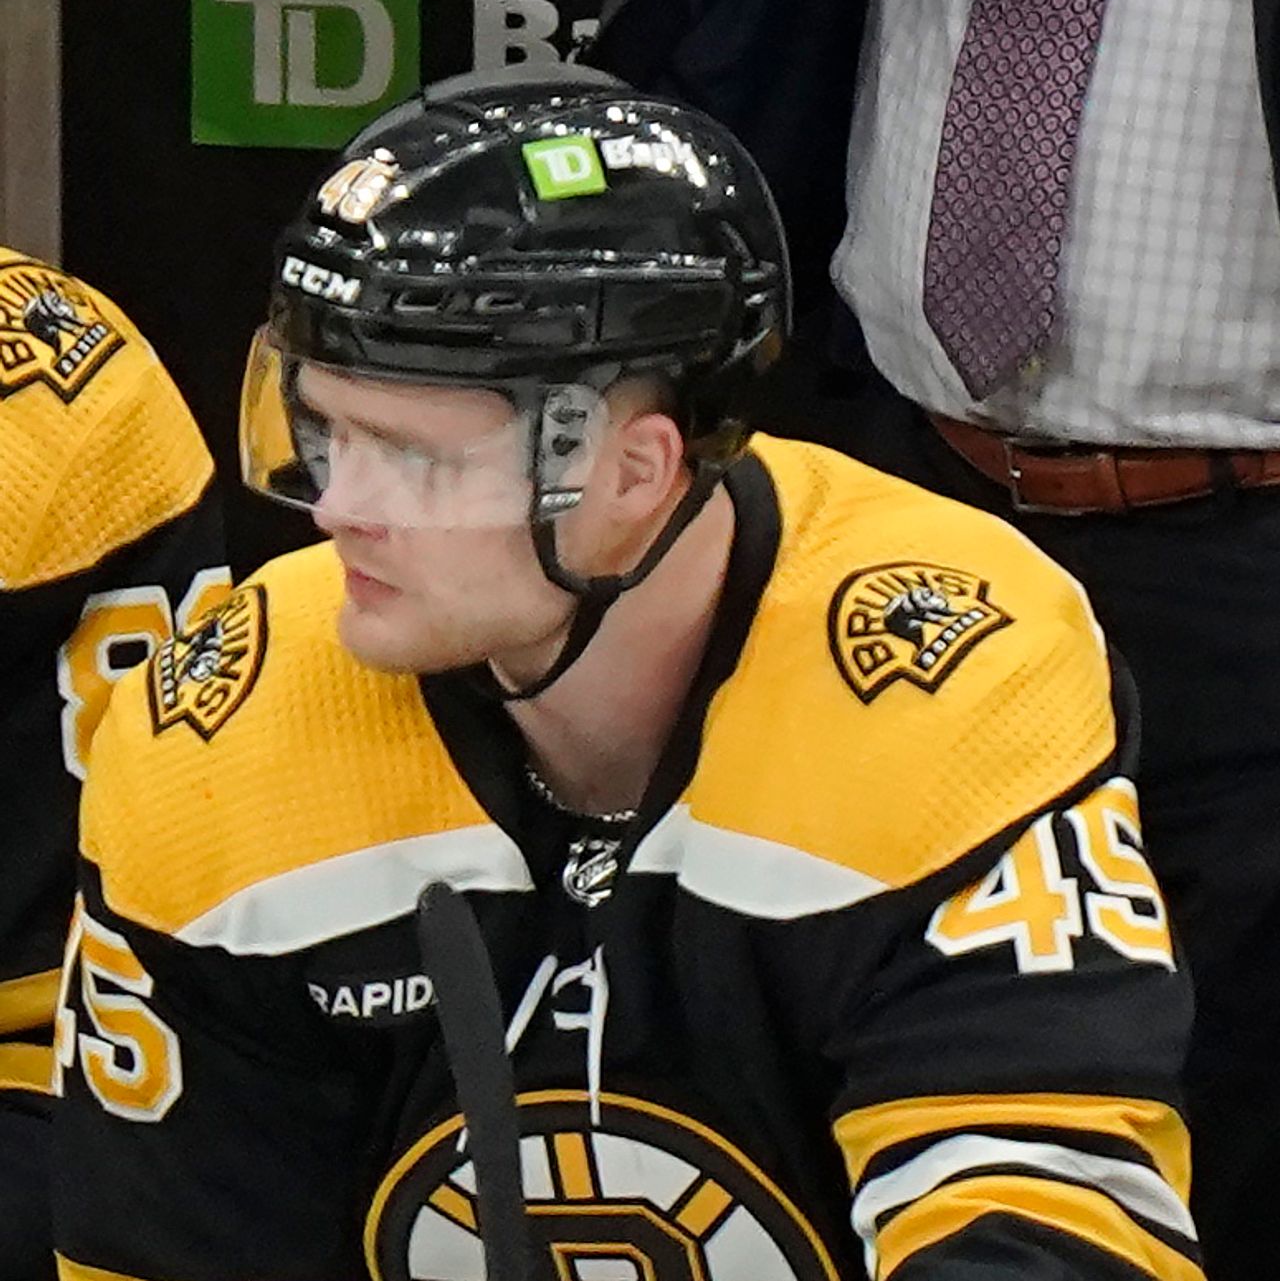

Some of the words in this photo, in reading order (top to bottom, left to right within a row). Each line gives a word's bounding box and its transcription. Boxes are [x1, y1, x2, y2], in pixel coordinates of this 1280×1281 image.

[534, 146, 594, 185] TD
[281, 255, 362, 305] CCM
[924, 776, 1179, 973] 45
[52, 890, 184, 1122] 5
